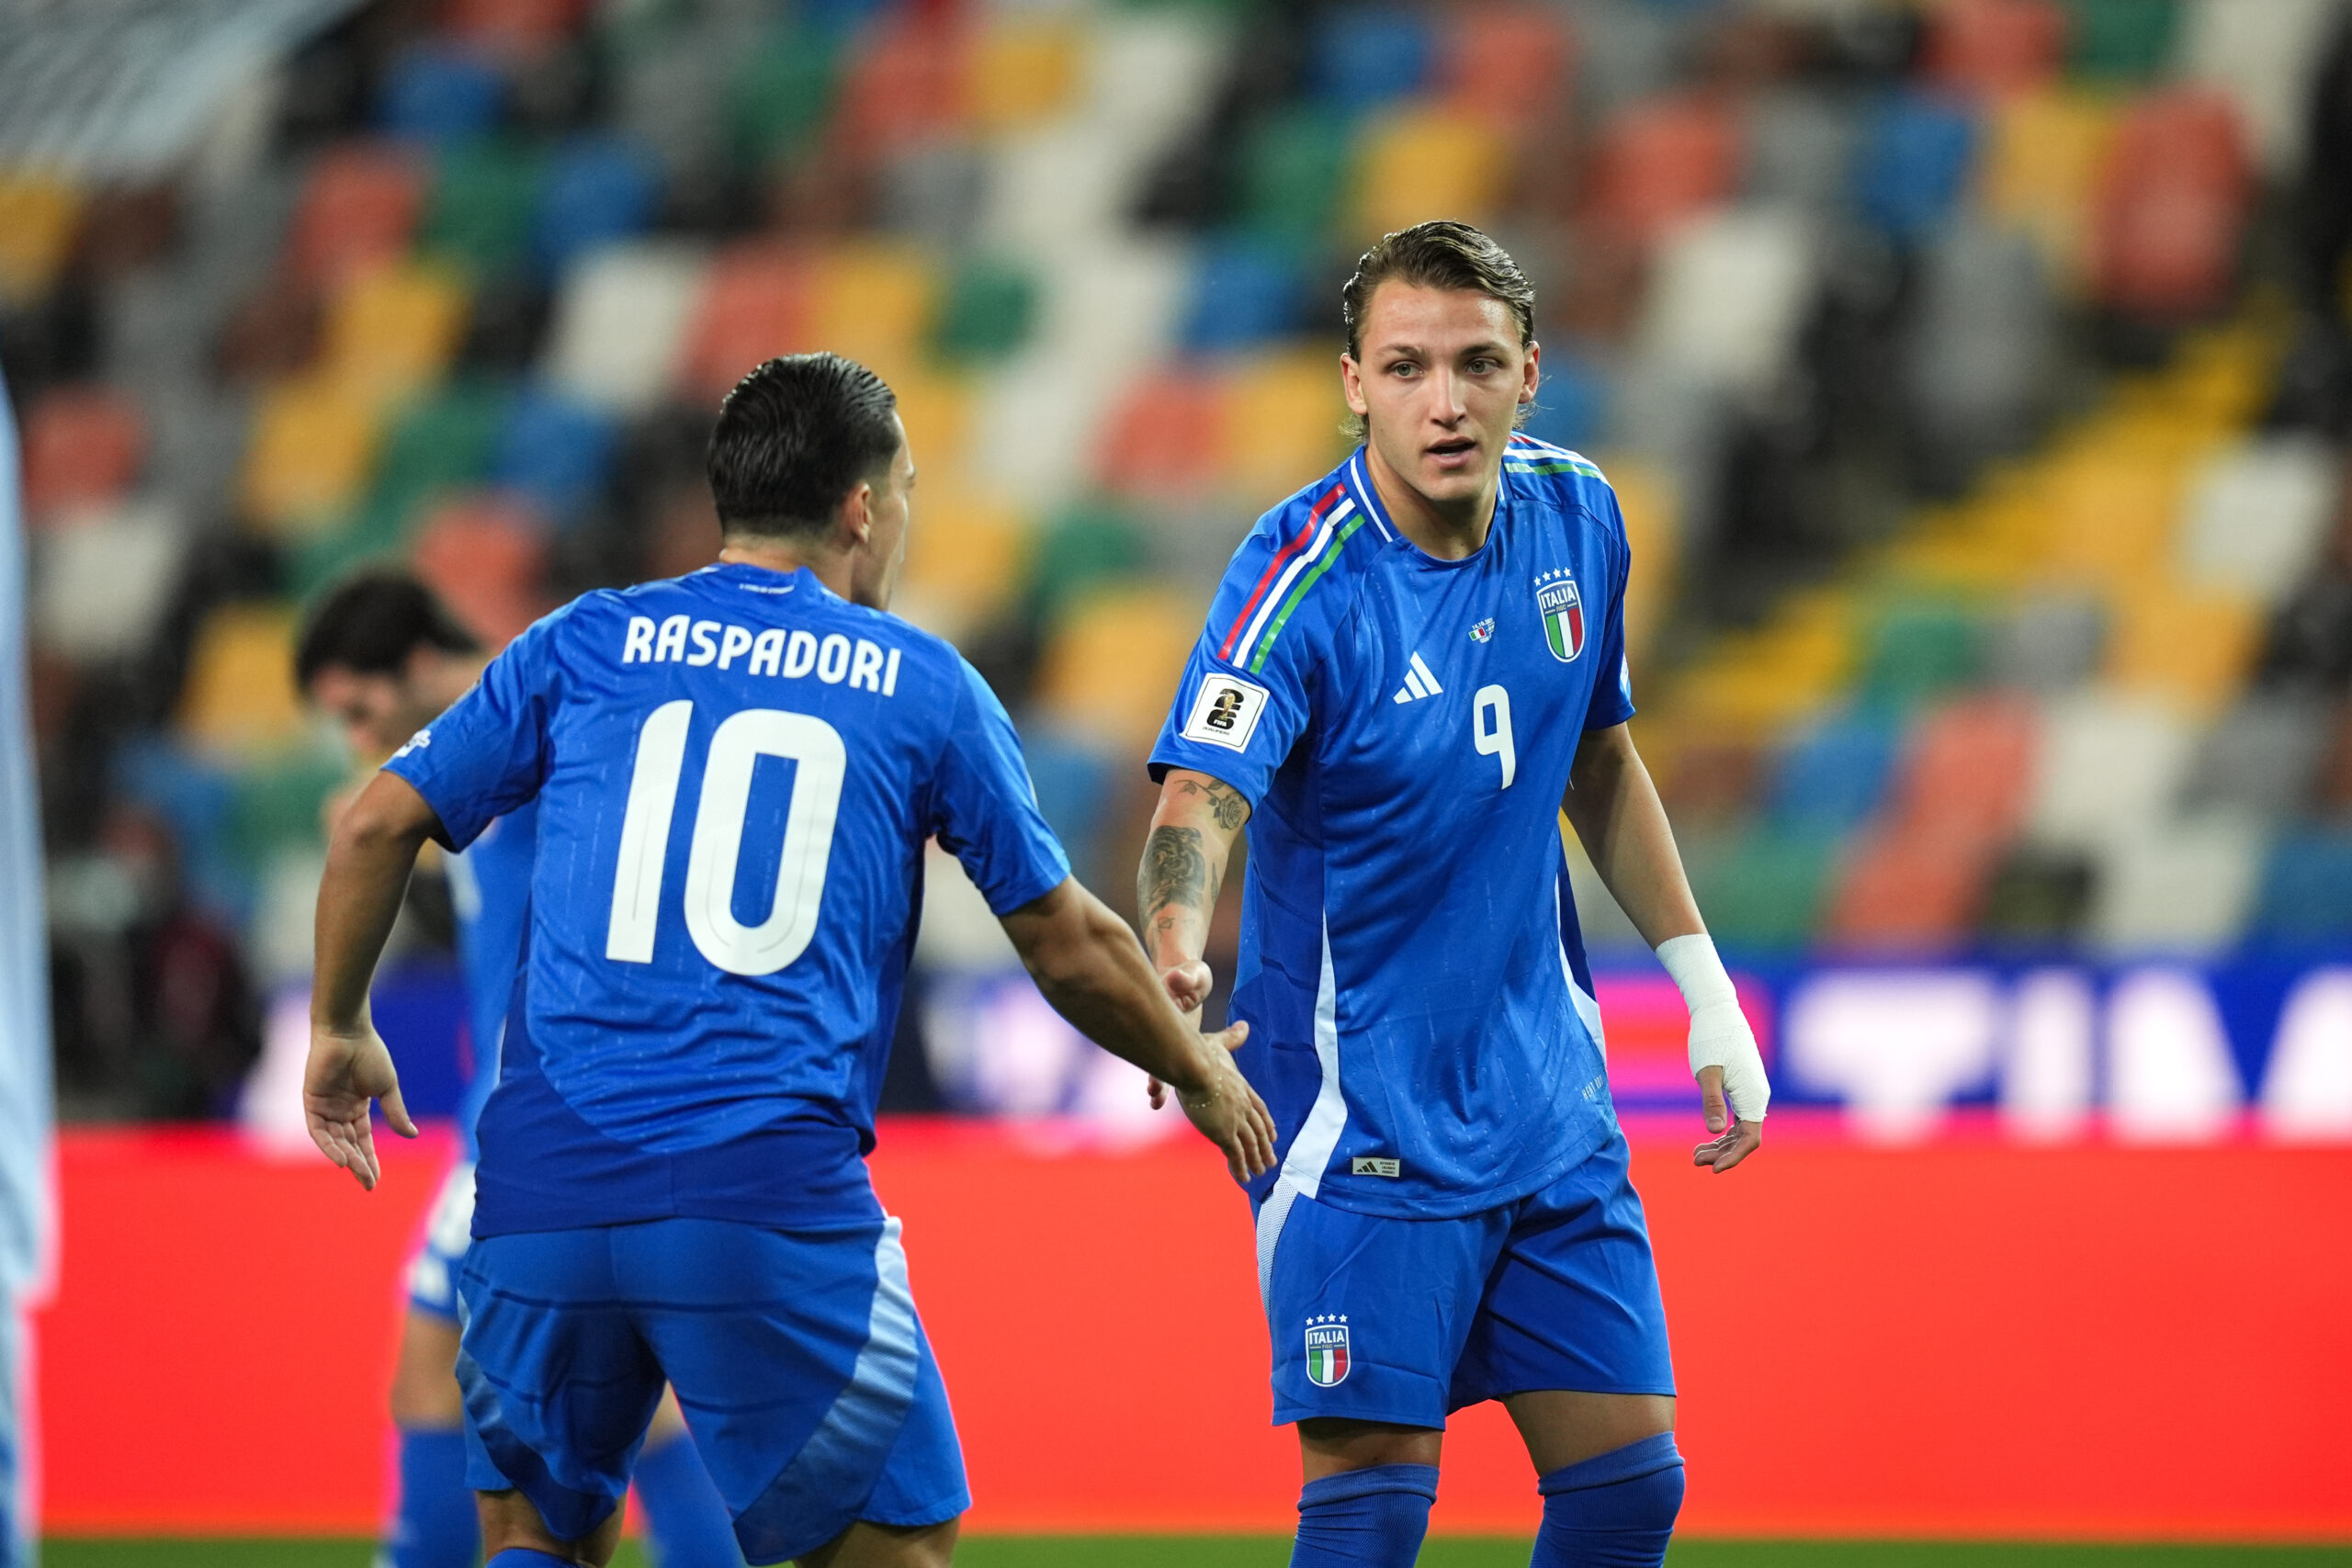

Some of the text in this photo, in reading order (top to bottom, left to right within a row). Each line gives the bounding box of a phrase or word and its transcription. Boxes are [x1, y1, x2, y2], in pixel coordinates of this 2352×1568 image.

[1541, 587, 1576, 609] ITALIA
[623, 615, 901, 697] RASPADORI
[1213, 718, 1227, 728] FIFA
[1473, 684, 1516, 790] 9
[605, 699, 846, 976] 10
[1308, 1330, 1345, 1345] ITALIA
